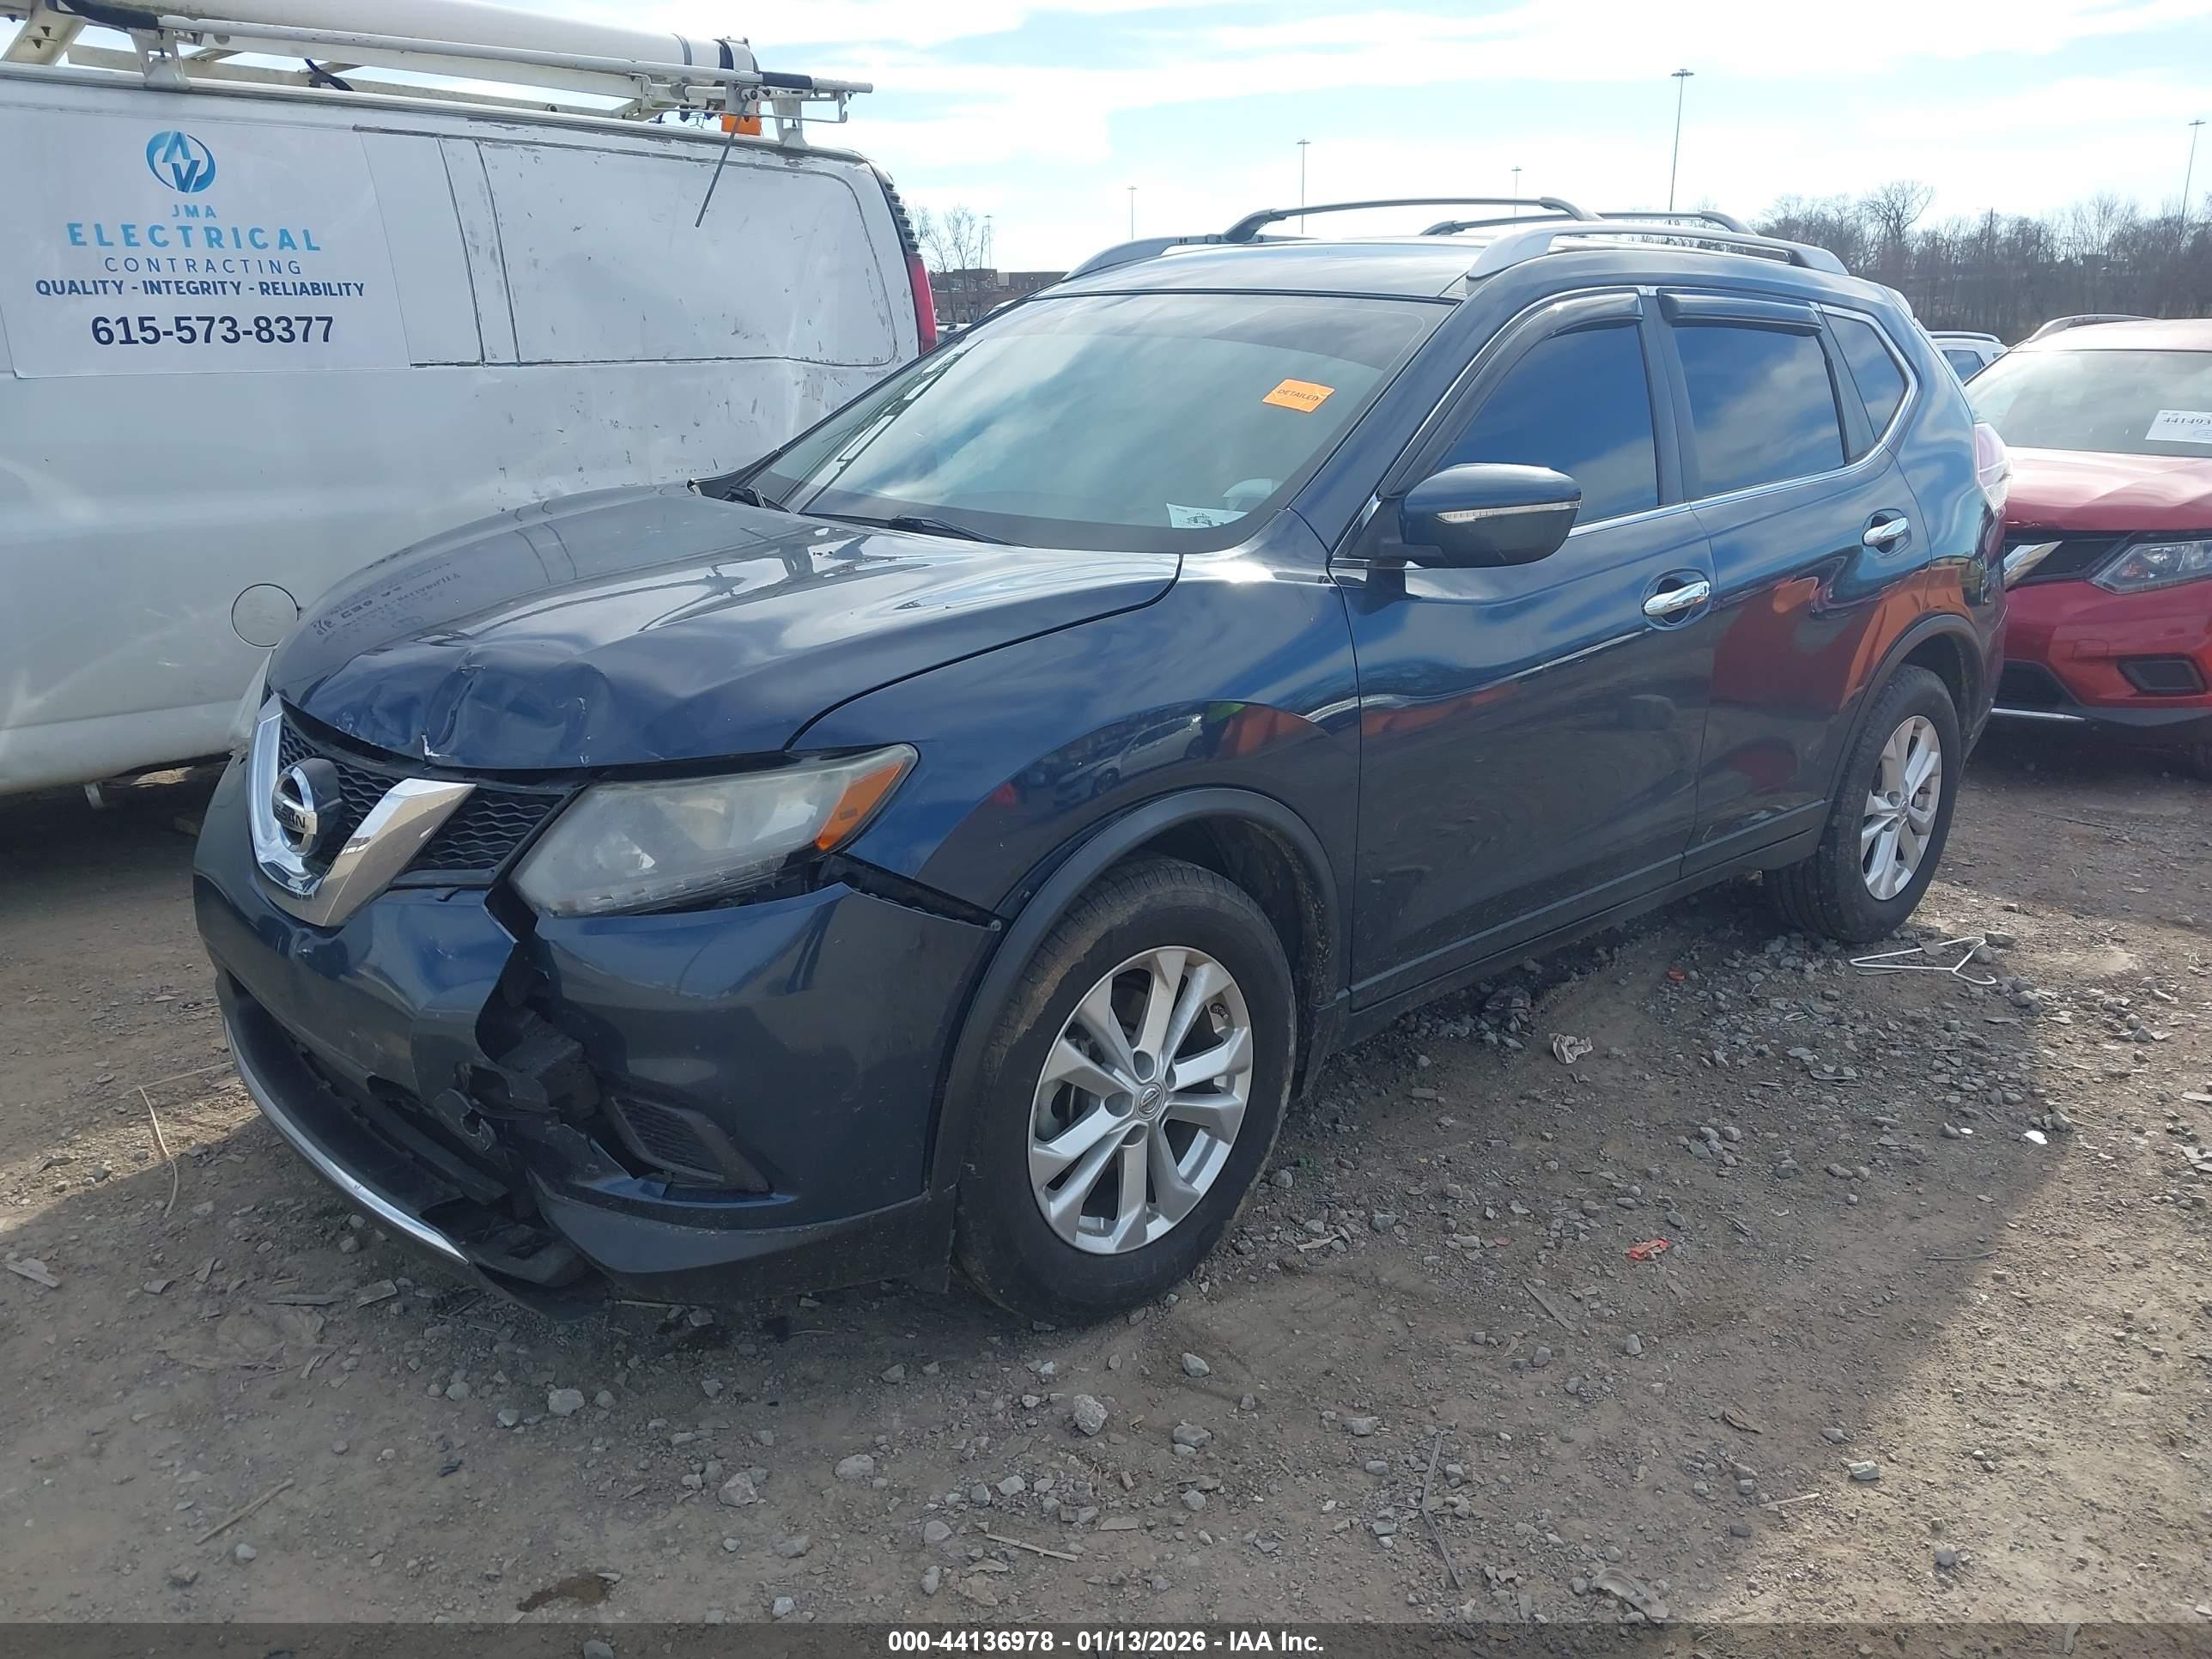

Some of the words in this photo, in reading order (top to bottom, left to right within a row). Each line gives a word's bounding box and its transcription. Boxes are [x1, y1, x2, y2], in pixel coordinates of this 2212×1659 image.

[172, 204, 216, 218] JMA
[67, 222, 321, 252] ELECTRICAL
[105, 257, 301, 275] CONTRACTING
[35, 279, 124, 295] QUALITY
[142, 280, 241, 295] INTEGRITY
[258, 281, 364, 296] RELIABILITY
[91, 315, 333, 345] 615-573-8377
[1277, 389, 1319, 401] DETAILED
